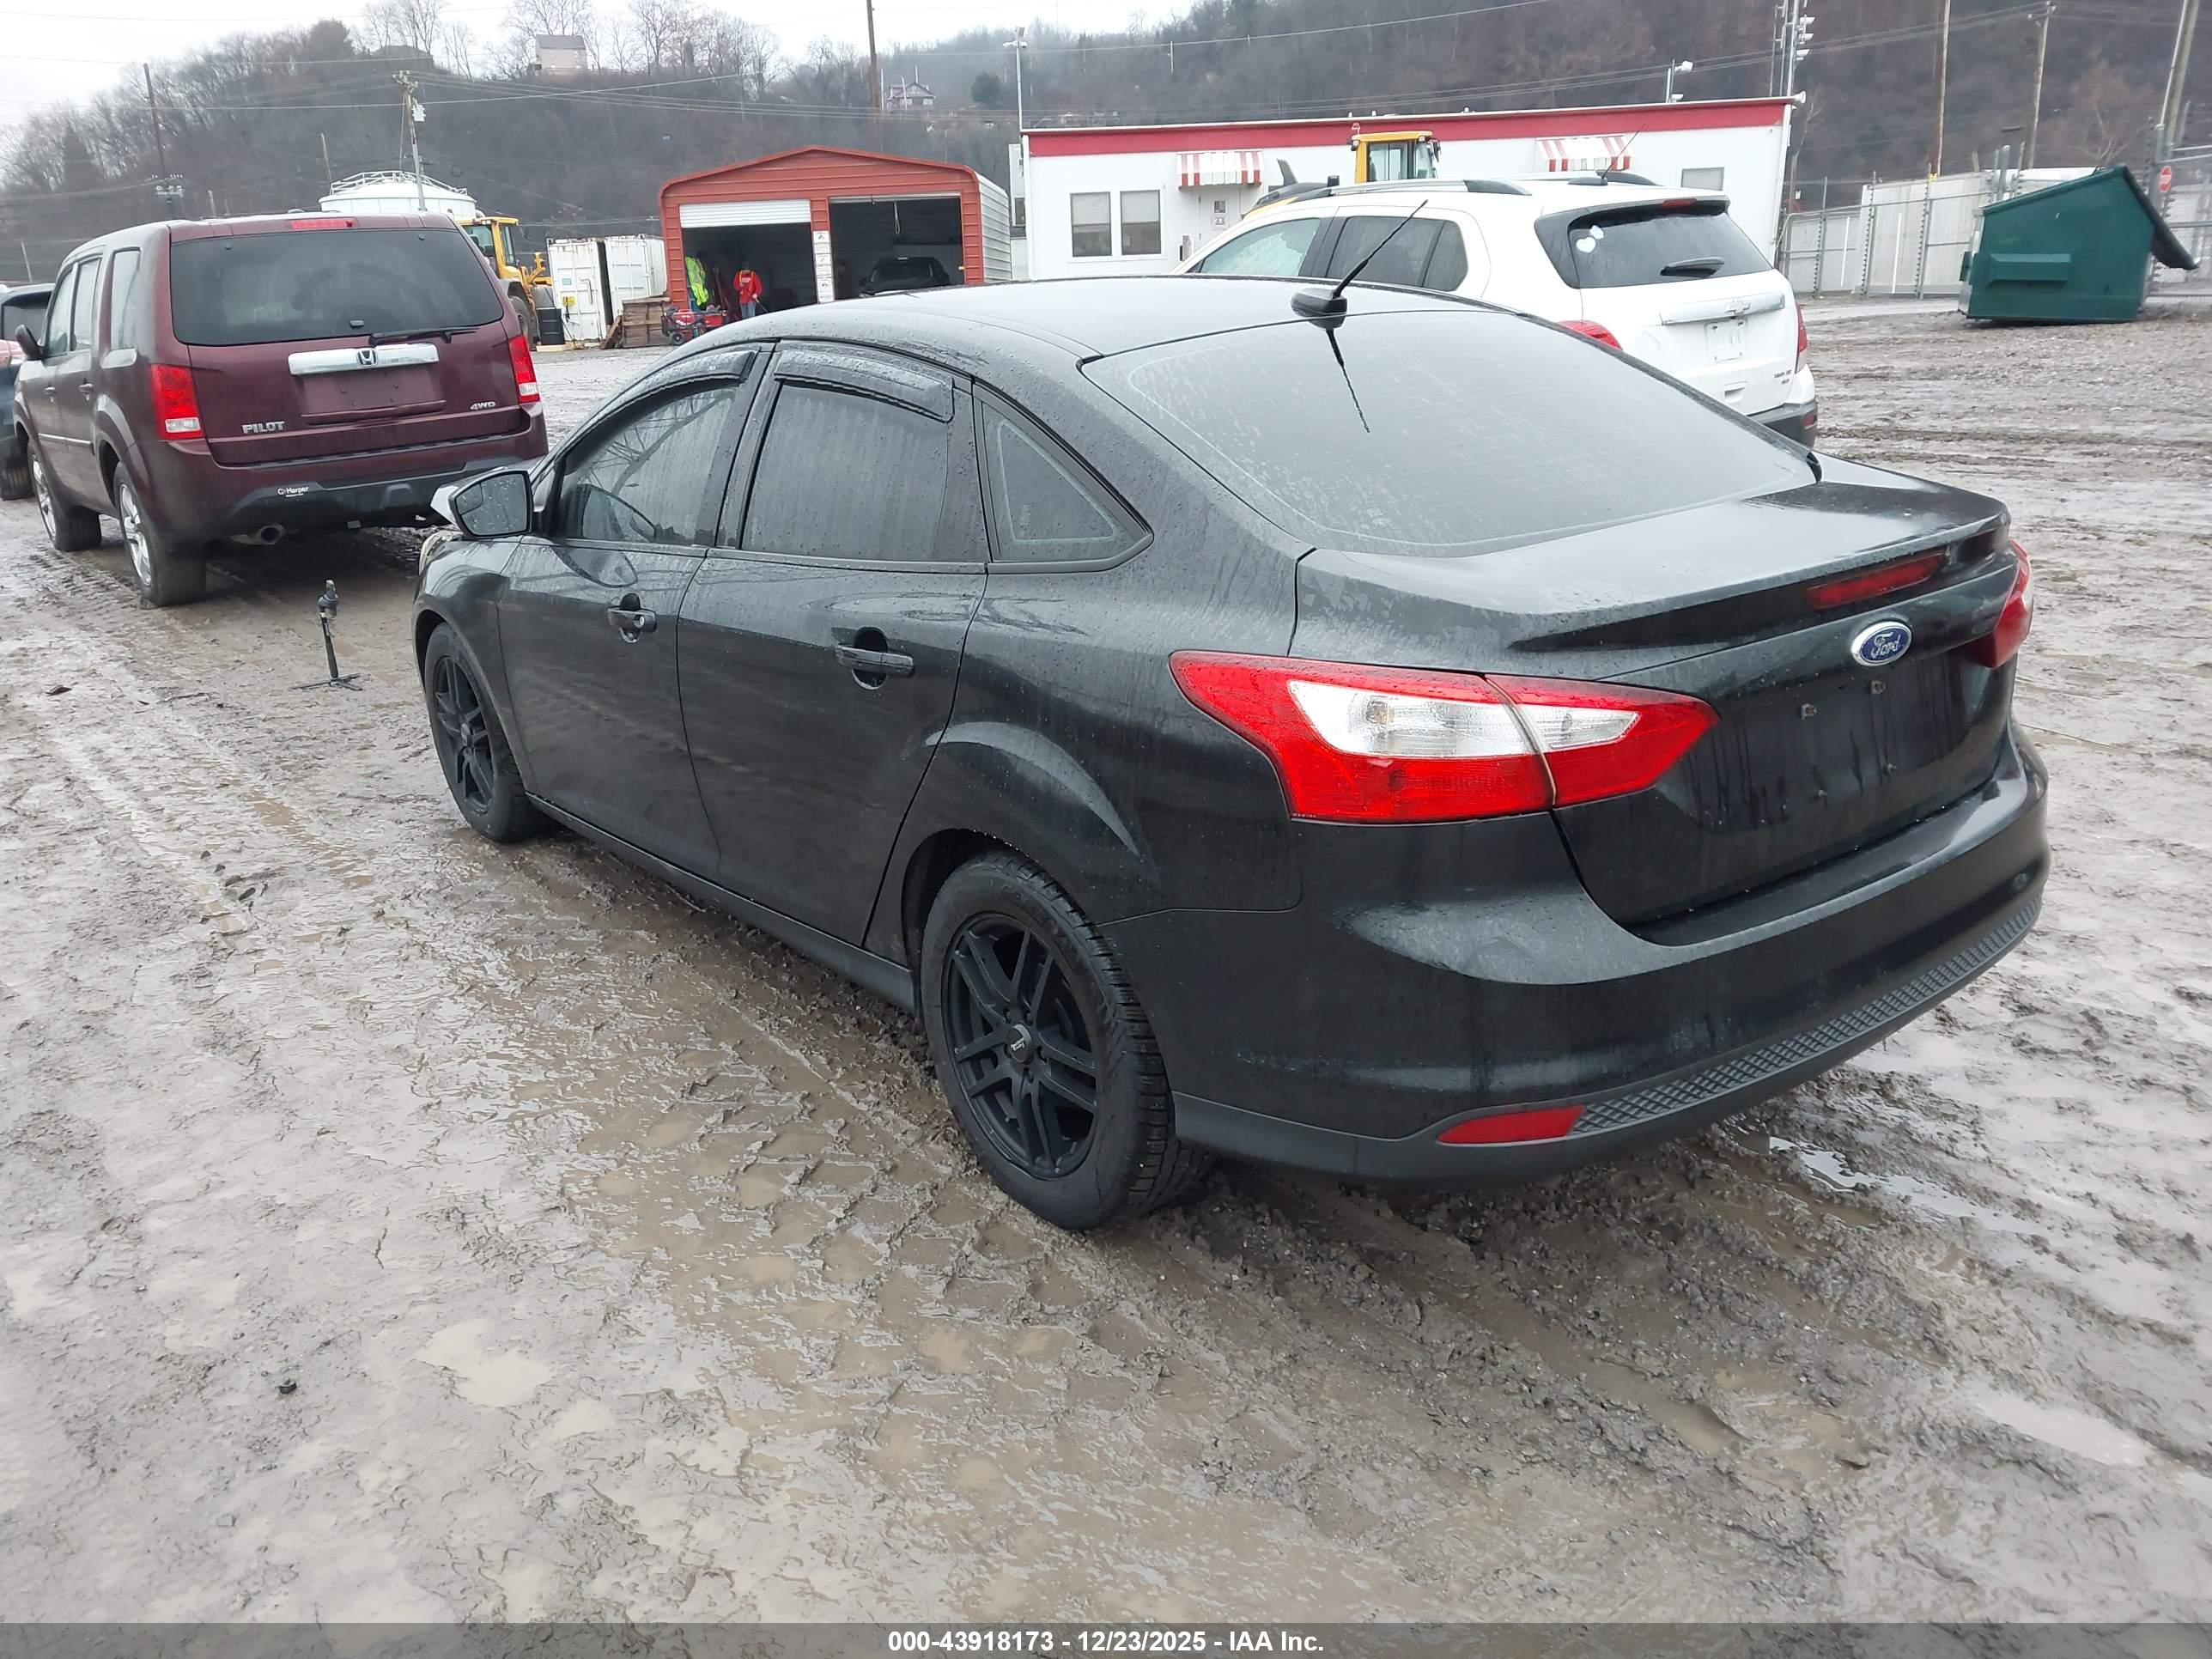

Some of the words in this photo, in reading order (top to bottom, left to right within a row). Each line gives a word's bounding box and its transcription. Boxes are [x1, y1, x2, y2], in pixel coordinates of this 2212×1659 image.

[470, 401, 495, 410] 4WD
[241, 421, 285, 434] PILOT
[1870, 631, 1901, 659] Ford
